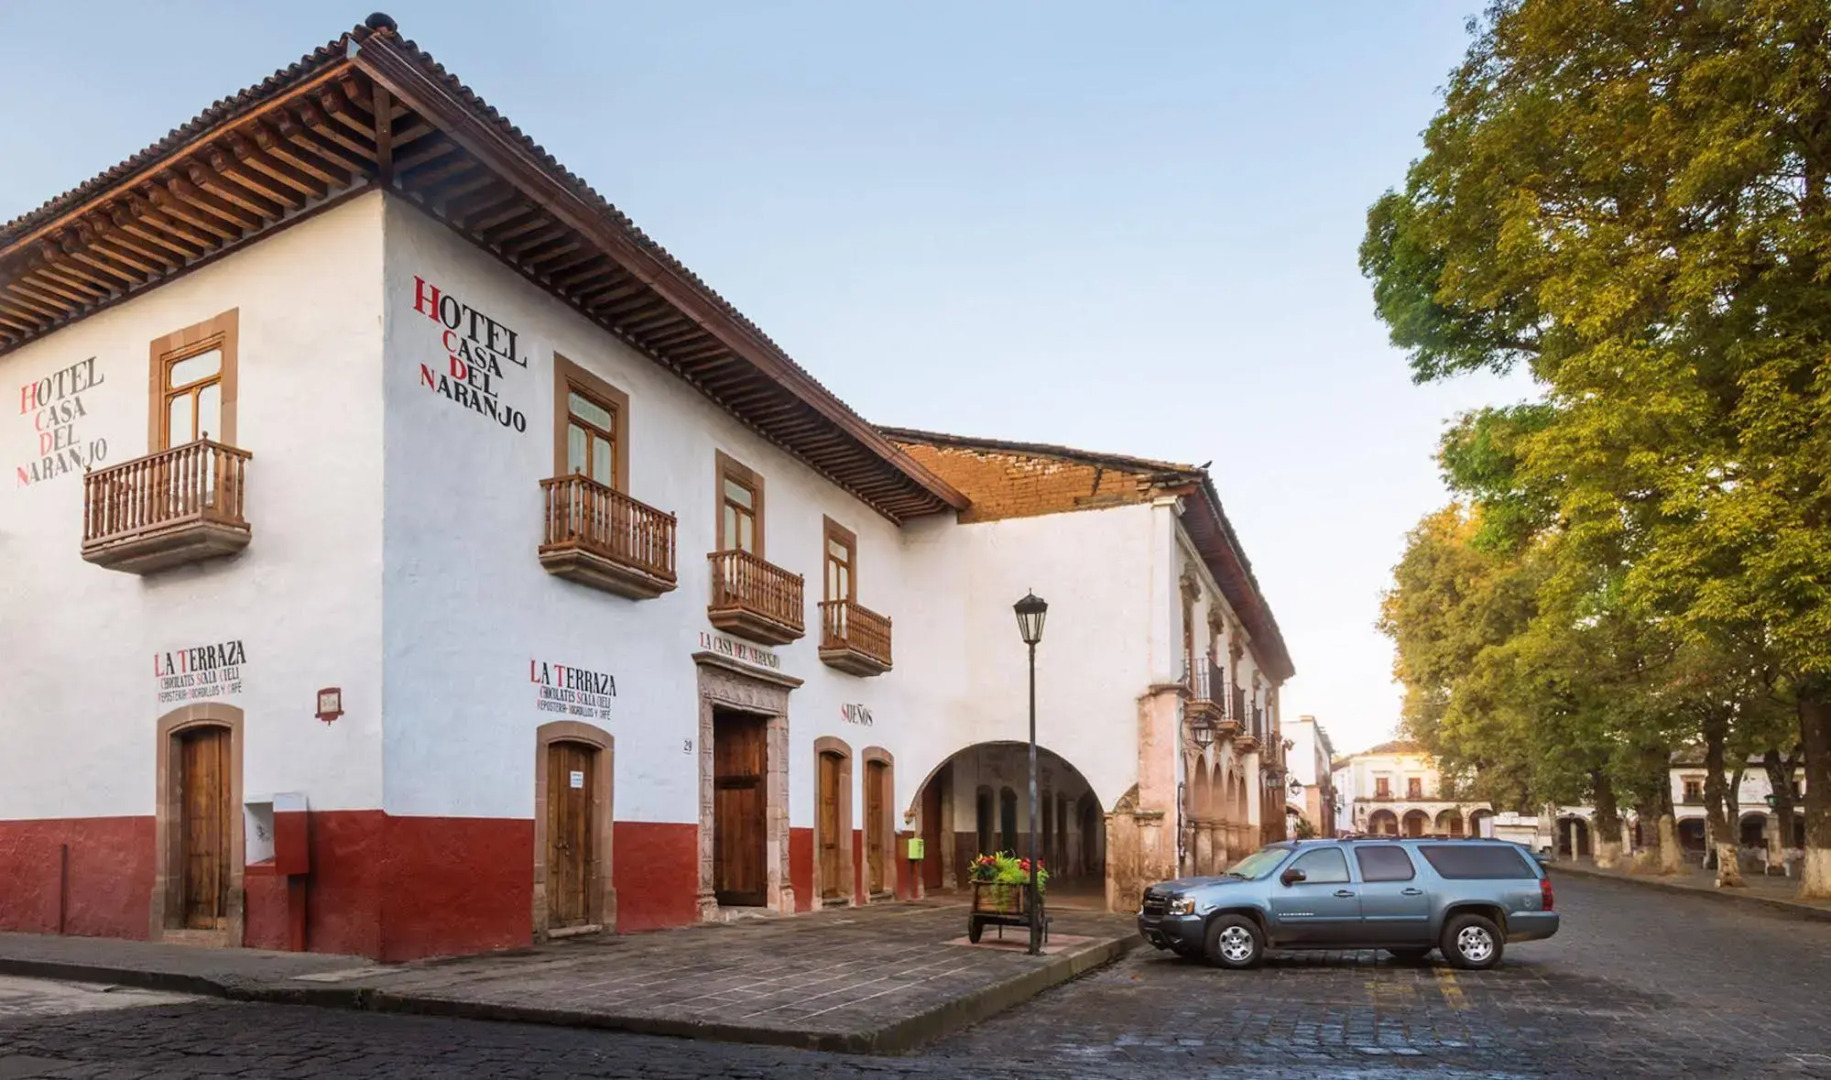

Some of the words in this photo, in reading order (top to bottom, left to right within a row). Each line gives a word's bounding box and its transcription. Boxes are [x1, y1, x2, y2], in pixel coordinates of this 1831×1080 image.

[413, 275, 527, 368] HOTEL
[442, 330, 504, 379] CASA
[450, 354, 498, 398] DEL
[20, 356, 104, 415] HOTEL
[420, 363, 526, 433] NARANJO
[35, 395, 87, 432] CASA
[39, 424, 80, 457] DEL
[17, 438, 107, 488] NARANJO
[154, 651, 175, 677] LA
[177, 640, 247, 674] TERRAZA
[700, 632, 711, 650] LA
[714, 636, 733, 655] CASA
[734, 643, 748, 661] DEL
[531, 660, 550, 685] LA
[554, 664, 617, 697] TERRAZA
